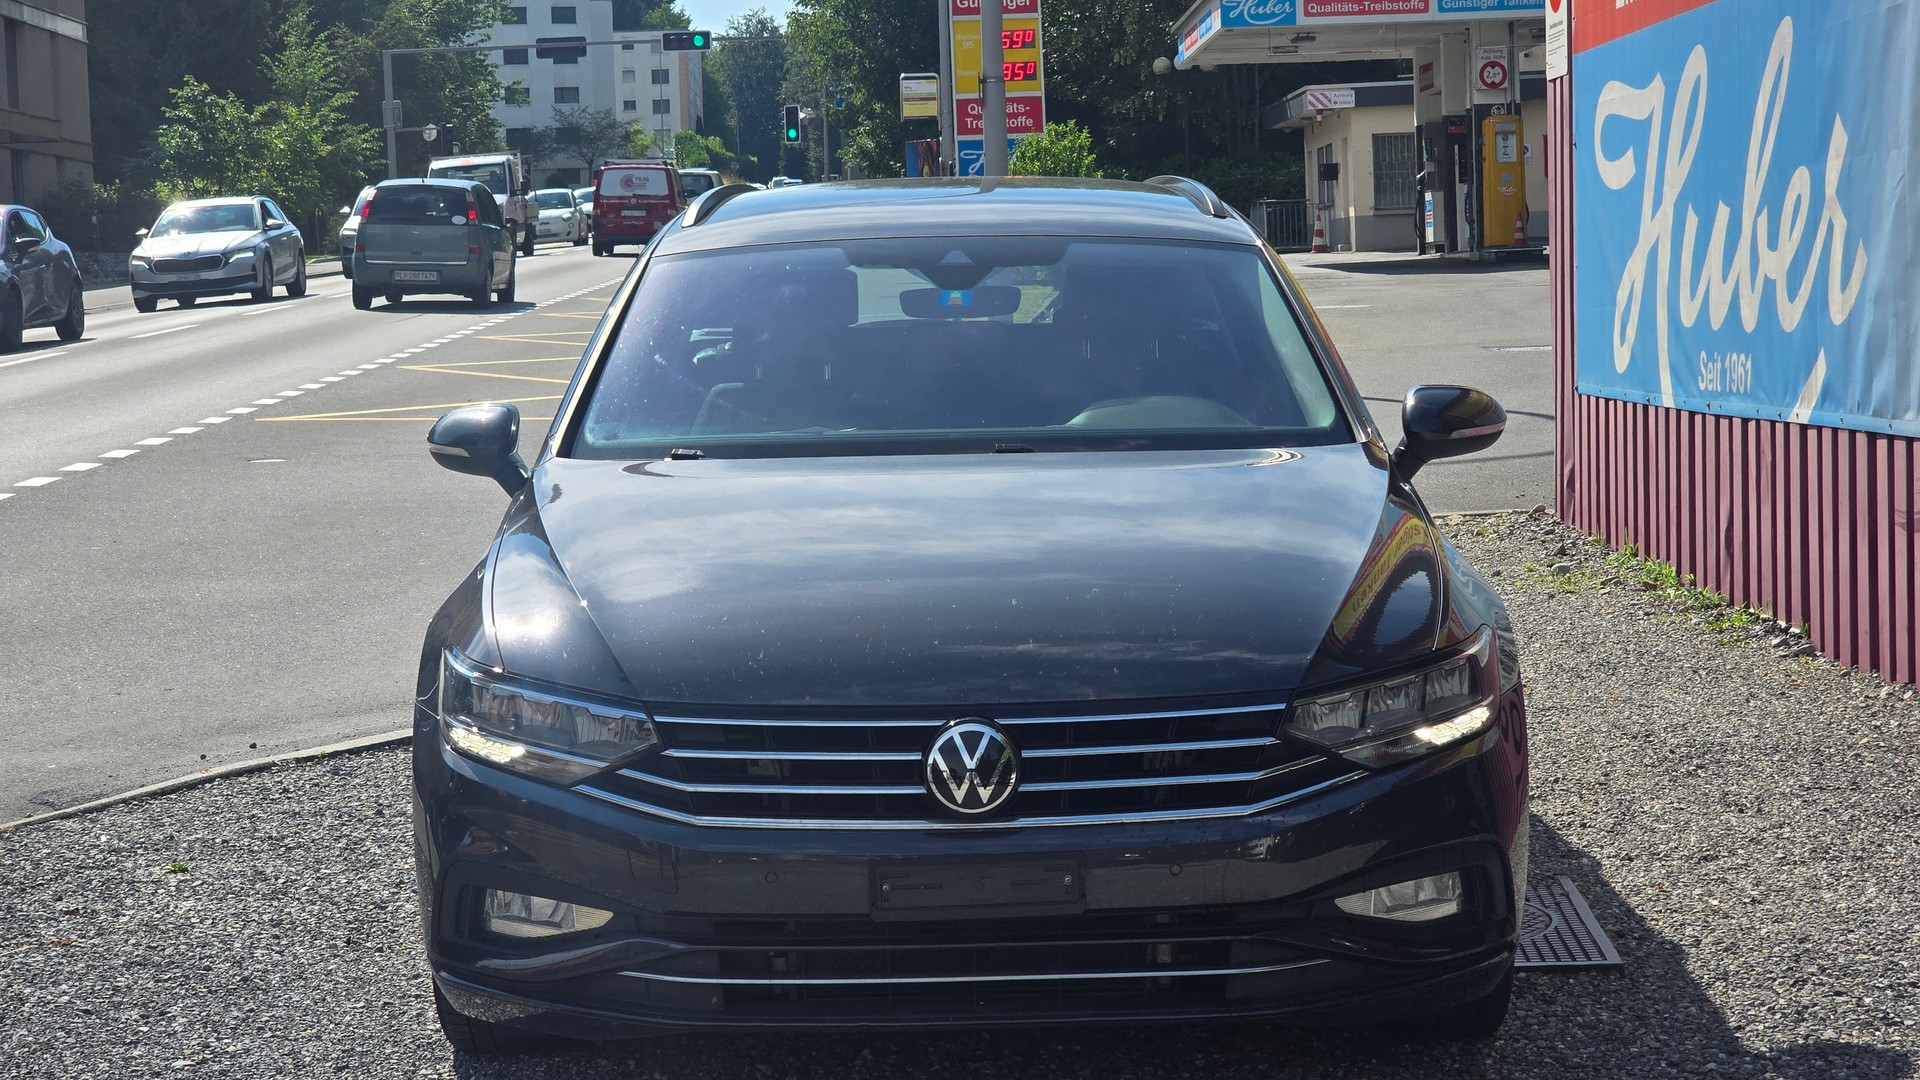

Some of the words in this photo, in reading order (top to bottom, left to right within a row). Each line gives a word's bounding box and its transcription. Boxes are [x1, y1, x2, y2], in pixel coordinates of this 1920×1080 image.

[1222, 0, 1293, 25] Huber
[1308, 0, 1425, 13] Qualitäts-Treibstoffe
[968, 102, 1030, 115] Quäts-
[965, 116, 1033, 129] Tretoffe
[1594, 15, 1868, 422] Huber
[1698, 350, 1721, 392] Seit
[1725, 352, 1752, 394] 1961
